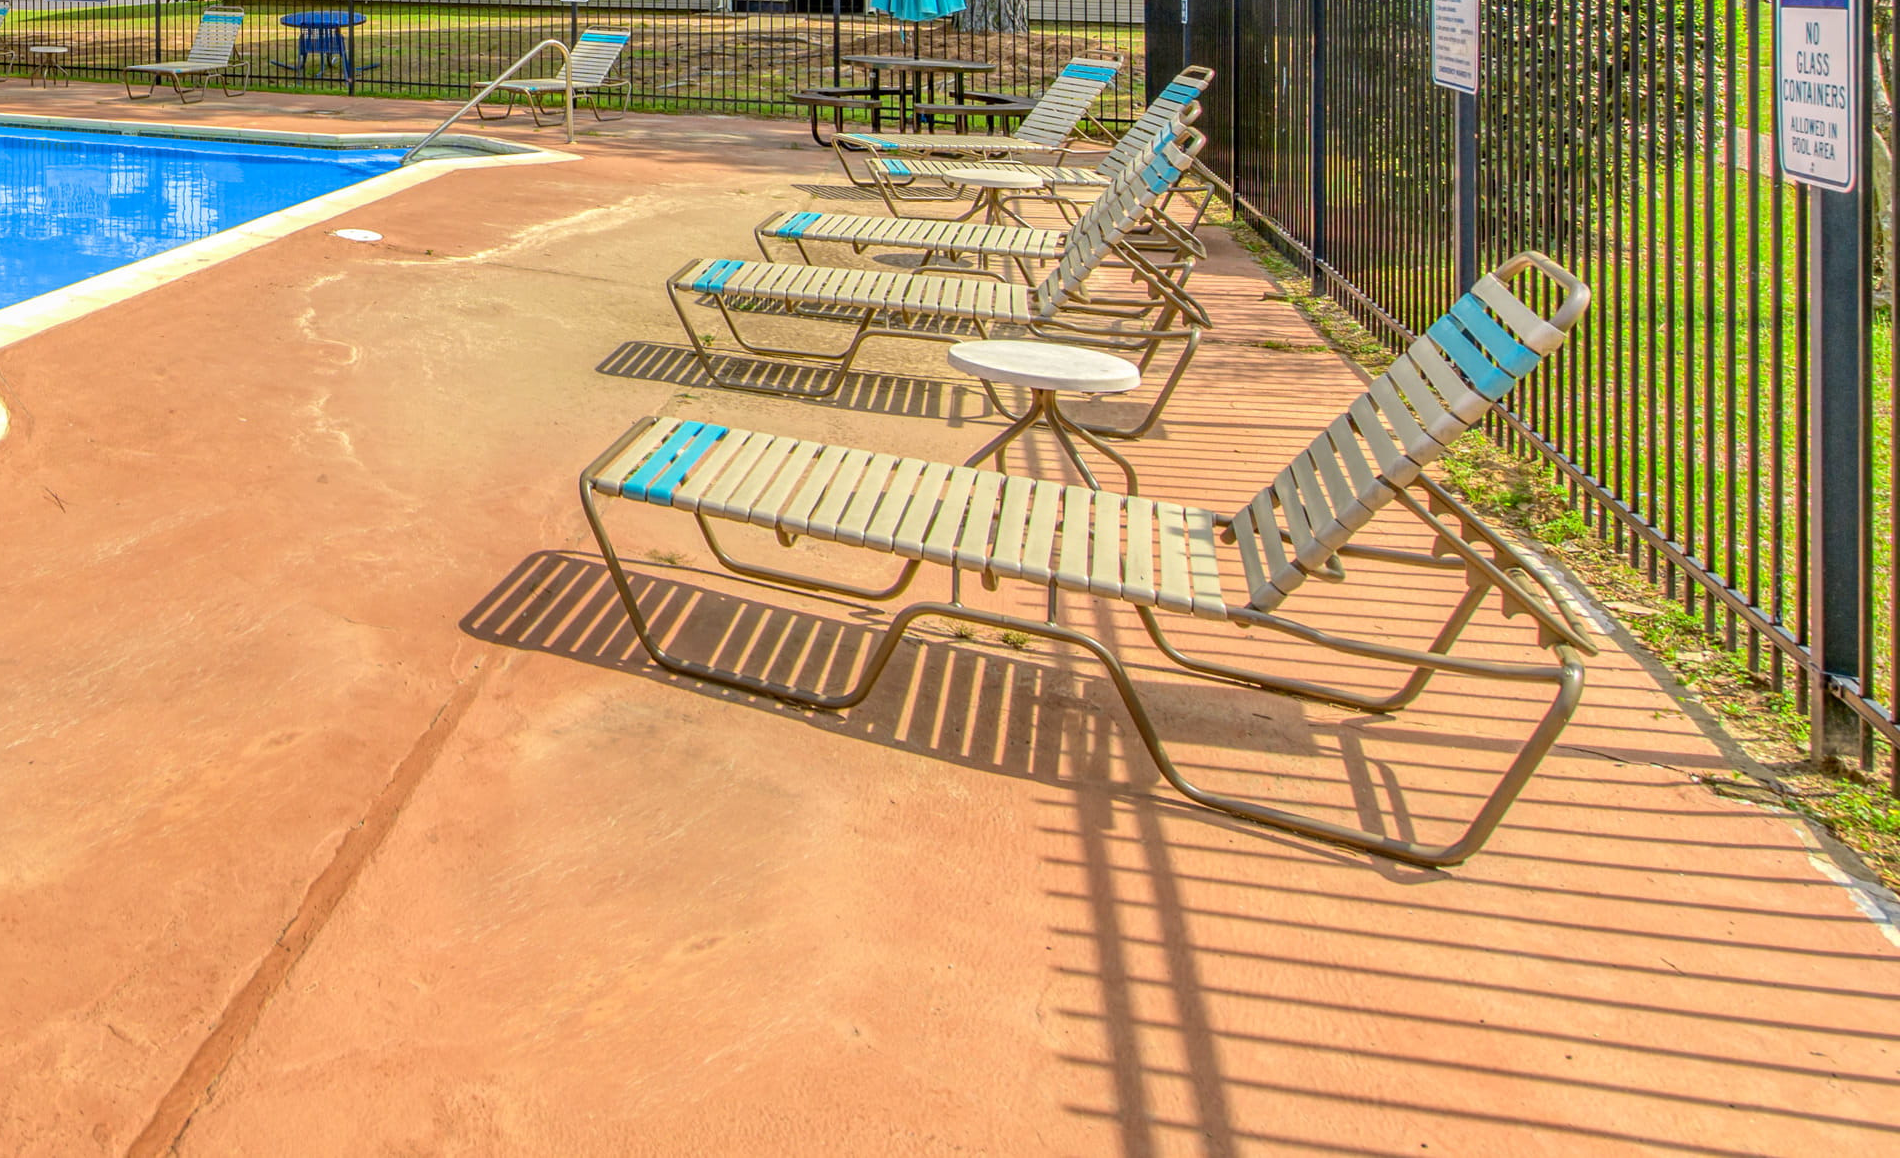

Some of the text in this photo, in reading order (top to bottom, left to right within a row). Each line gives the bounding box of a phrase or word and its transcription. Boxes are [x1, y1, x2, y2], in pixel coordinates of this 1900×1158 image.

[1805, 21, 1820, 46] NO
[1796, 50, 1830, 77] GLASS
[1783, 78, 1846, 110] CONTAINERS
[1791, 115, 1838, 139] ALLOWED IN
[1792, 136, 1836, 161] POOL AREA
